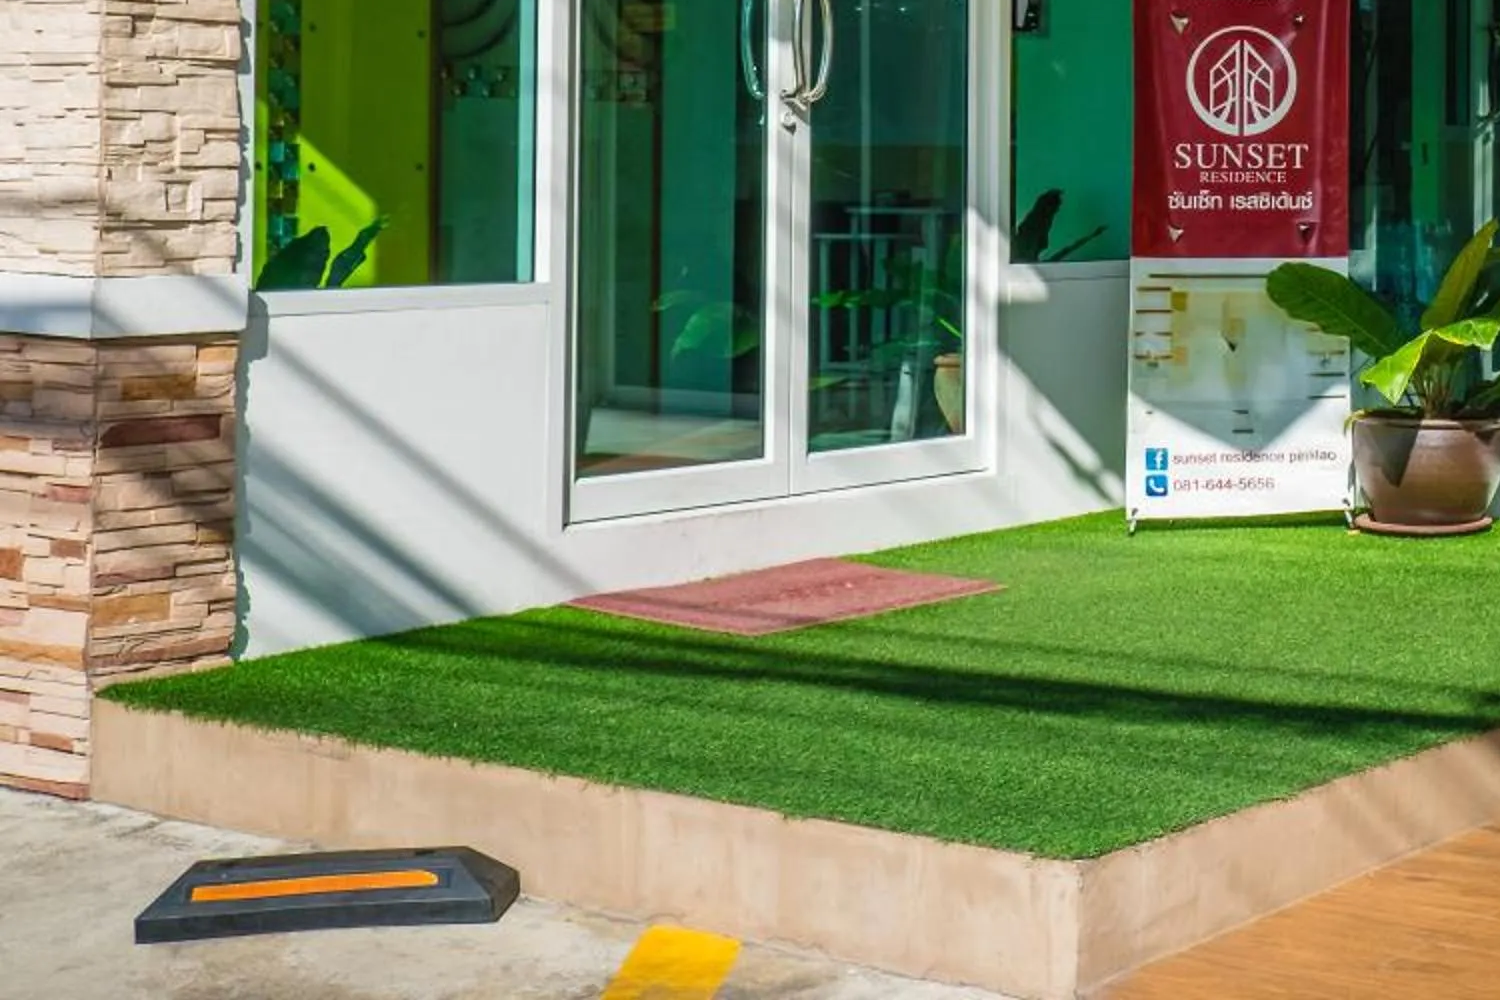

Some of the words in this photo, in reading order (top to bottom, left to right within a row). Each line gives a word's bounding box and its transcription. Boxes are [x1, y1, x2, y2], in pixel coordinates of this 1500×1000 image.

[1175, 143, 1309, 169] SUNSET
[1199, 171, 1287, 183] RESIDENCE
[1172, 451, 1217, 465] sunset
